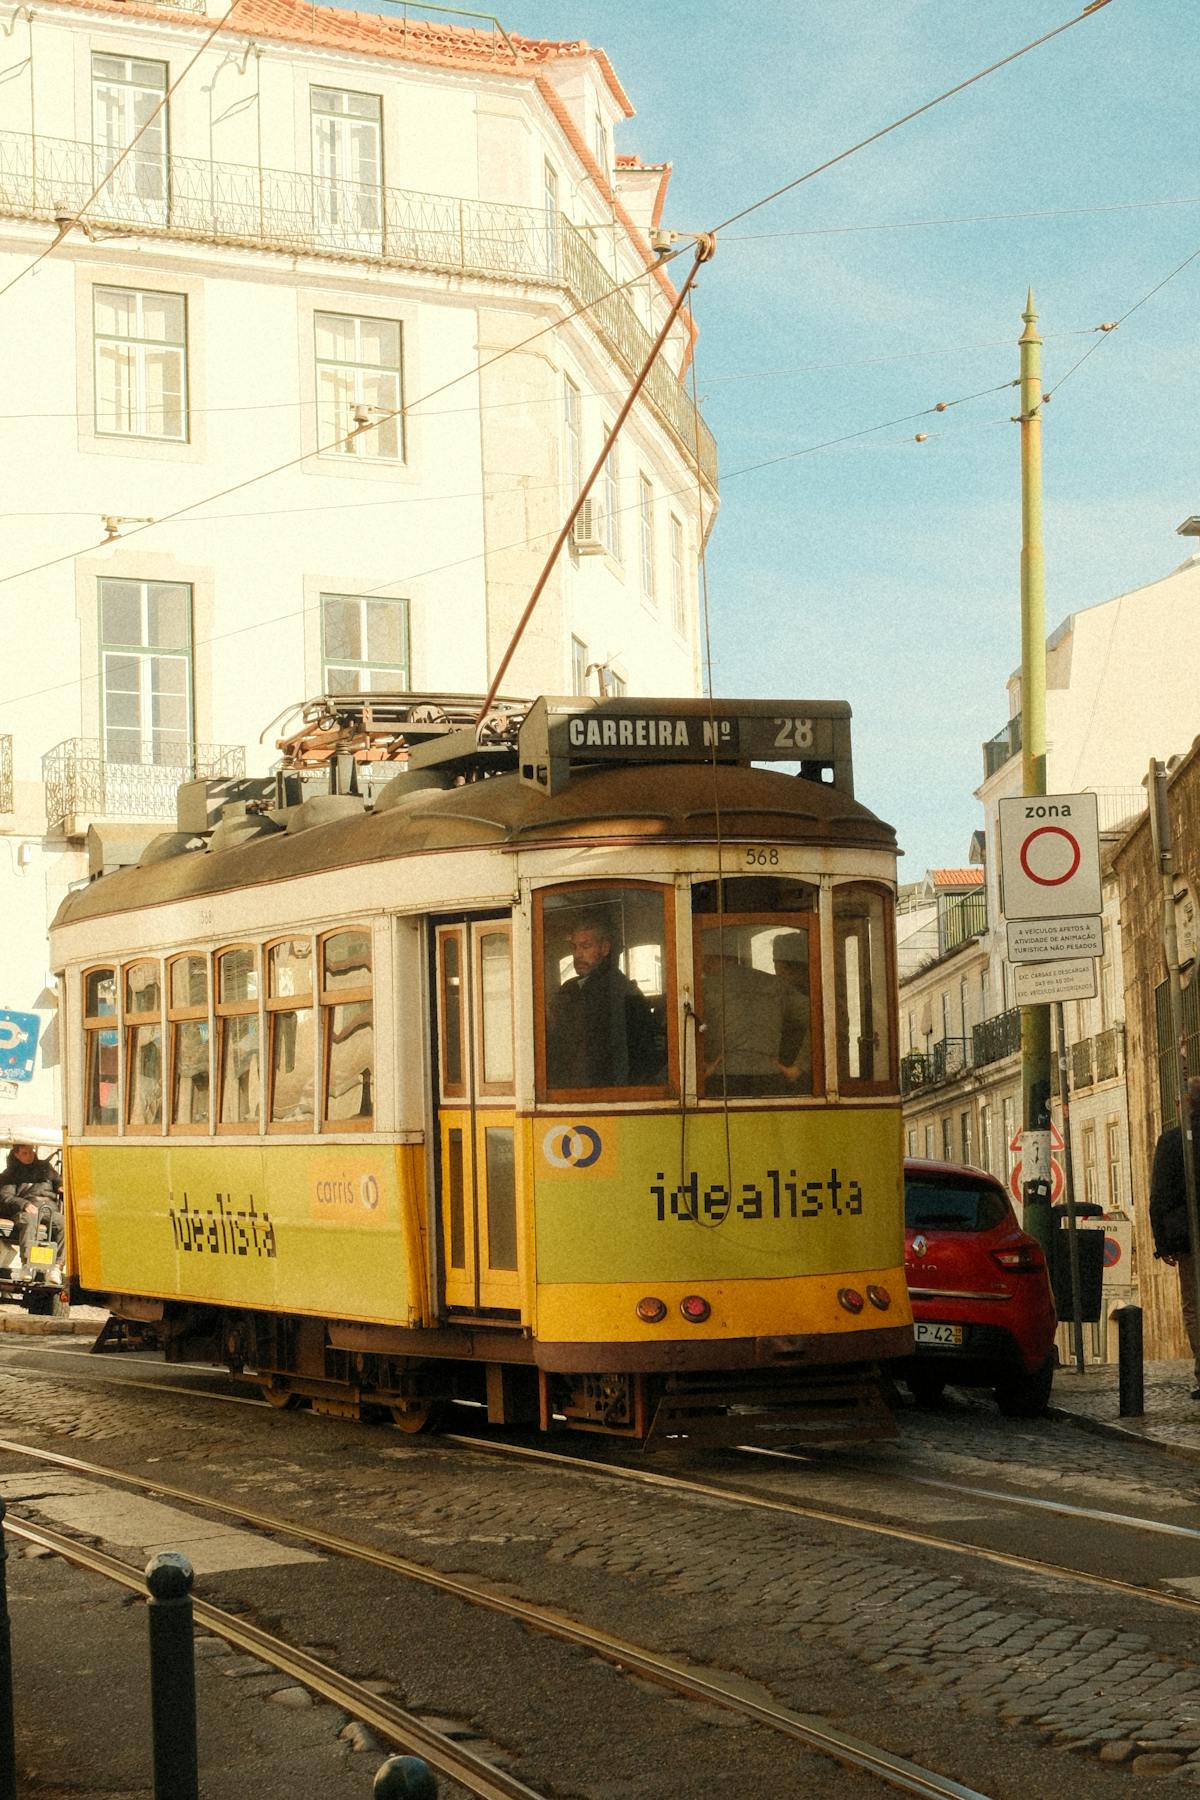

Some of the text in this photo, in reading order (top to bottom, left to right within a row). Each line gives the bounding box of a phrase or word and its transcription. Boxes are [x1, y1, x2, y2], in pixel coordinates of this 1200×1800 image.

[569, 718, 689, 746] CARREIRA
[774, 718, 814, 748] 28
[1025, 805, 1072, 818] zona
[746, 849, 779, 866] 568
[1014, 937, 1048, 945] ATIVIDADE
[317, 1172, 354, 1204] carris
[651, 1168, 863, 1221] idealista
[169, 1192, 277, 1258] idealista
